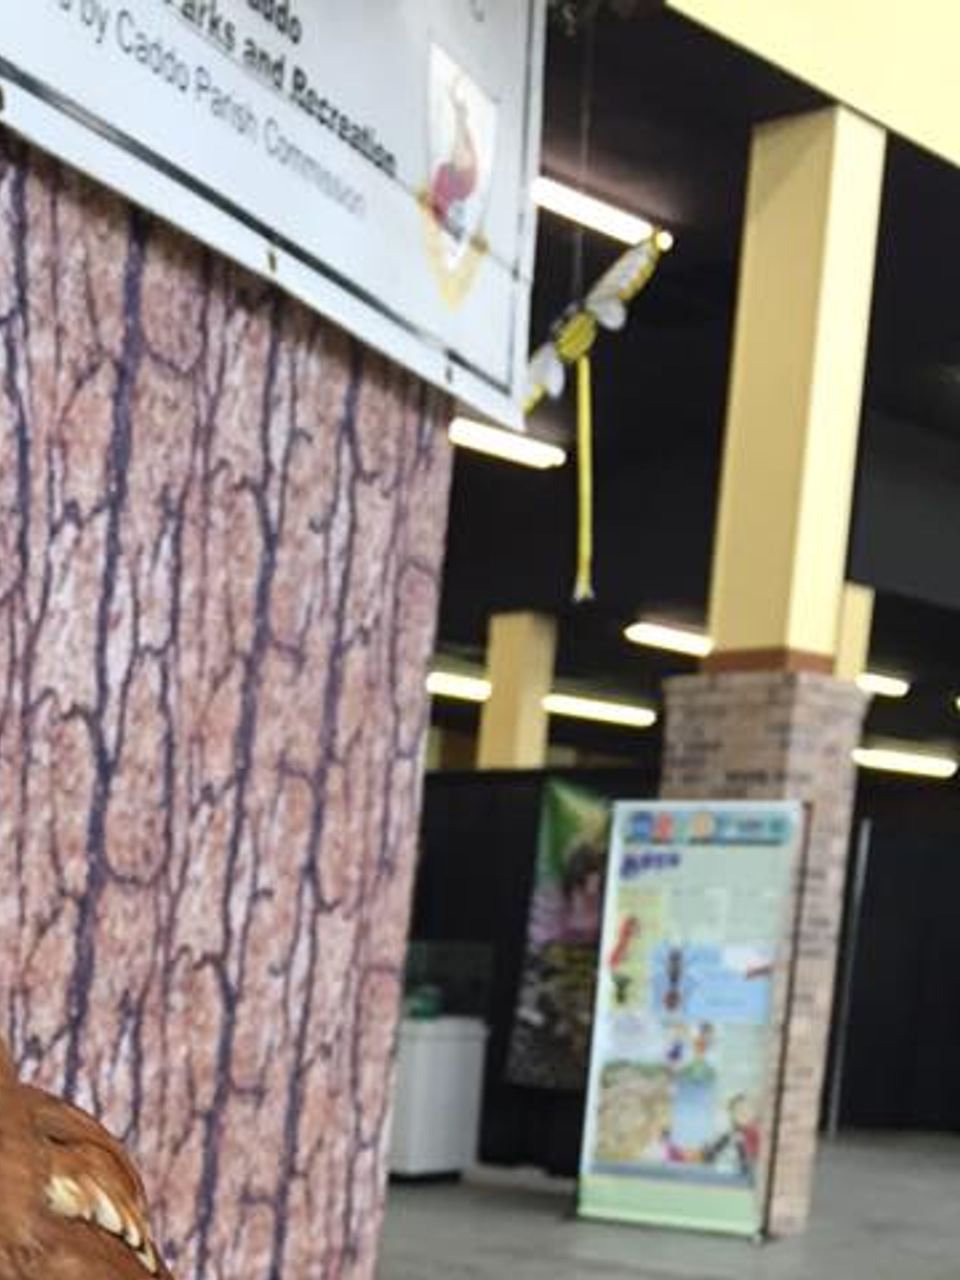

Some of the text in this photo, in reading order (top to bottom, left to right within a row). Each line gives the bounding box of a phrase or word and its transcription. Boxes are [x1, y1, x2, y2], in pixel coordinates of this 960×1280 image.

[80, 0, 108, 44] by
[116, 9, 190, 92] Caddo
[243, 37, 285, 90] and
[290, 66, 397, 178] Recreation
